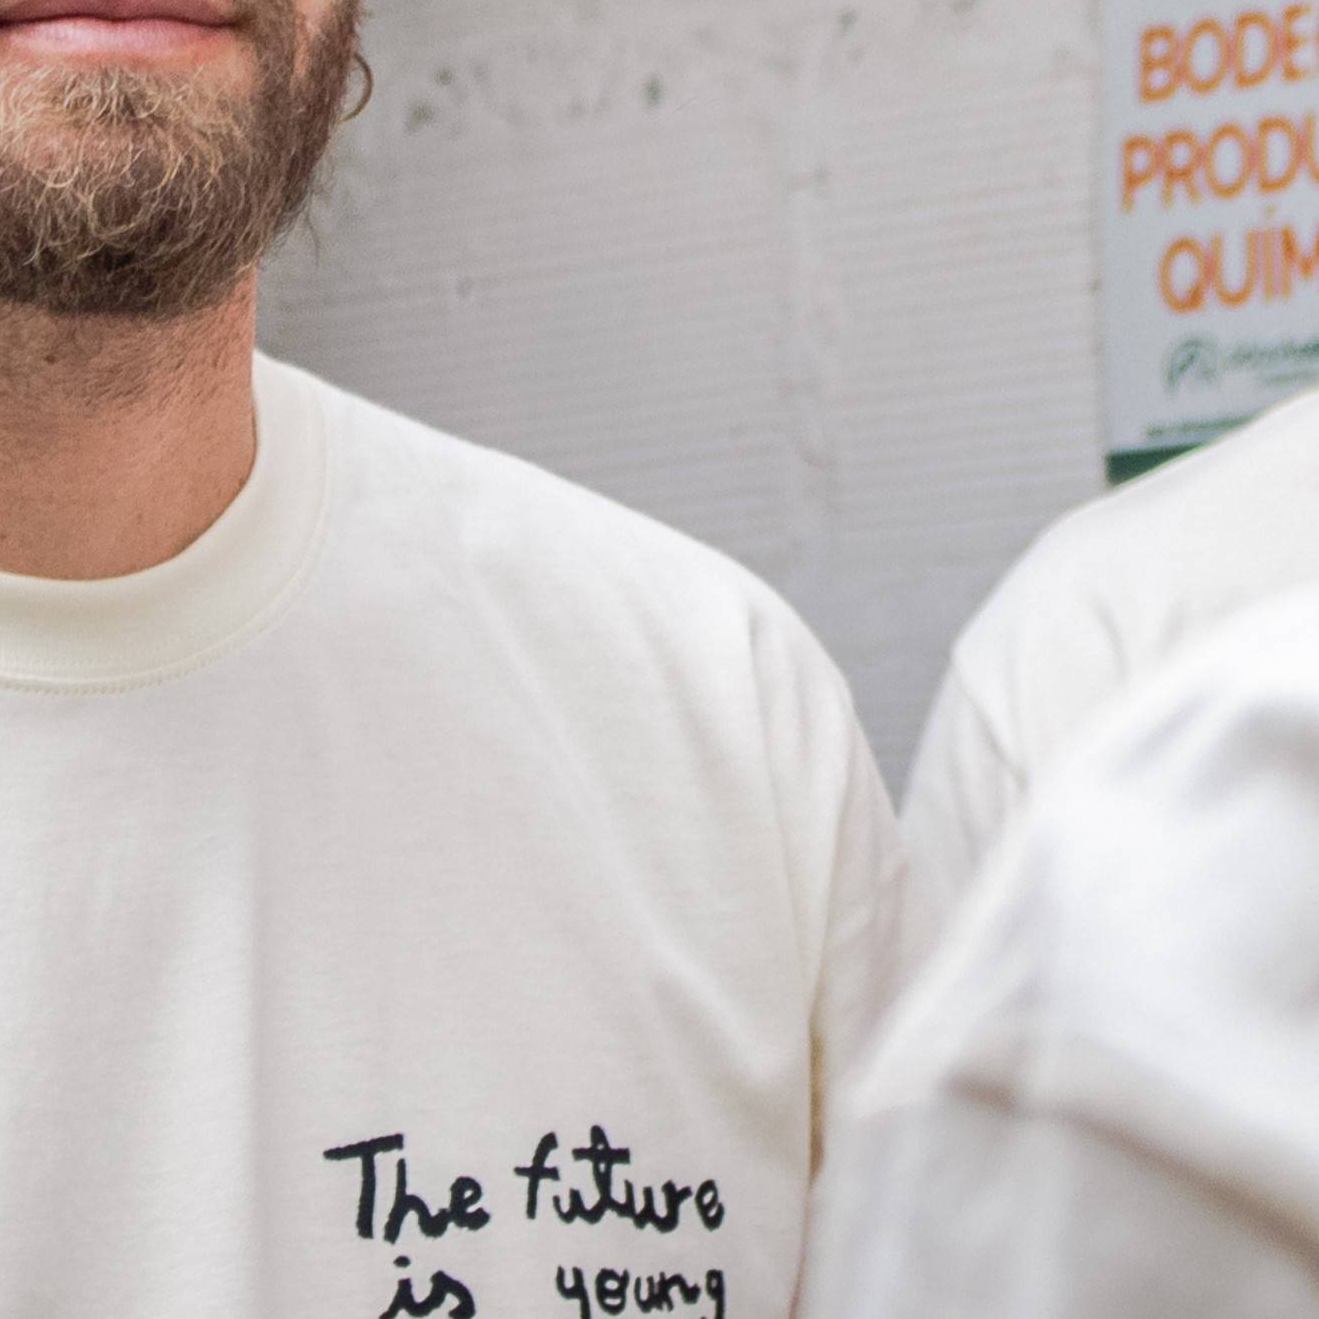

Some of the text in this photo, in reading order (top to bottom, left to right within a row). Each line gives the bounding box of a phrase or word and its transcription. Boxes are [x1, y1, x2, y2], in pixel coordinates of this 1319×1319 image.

[1137, 2, 1314, 104] BODE
[322, 1124, 726, 1244] The future
[378, 1255, 726, 1319] is young
